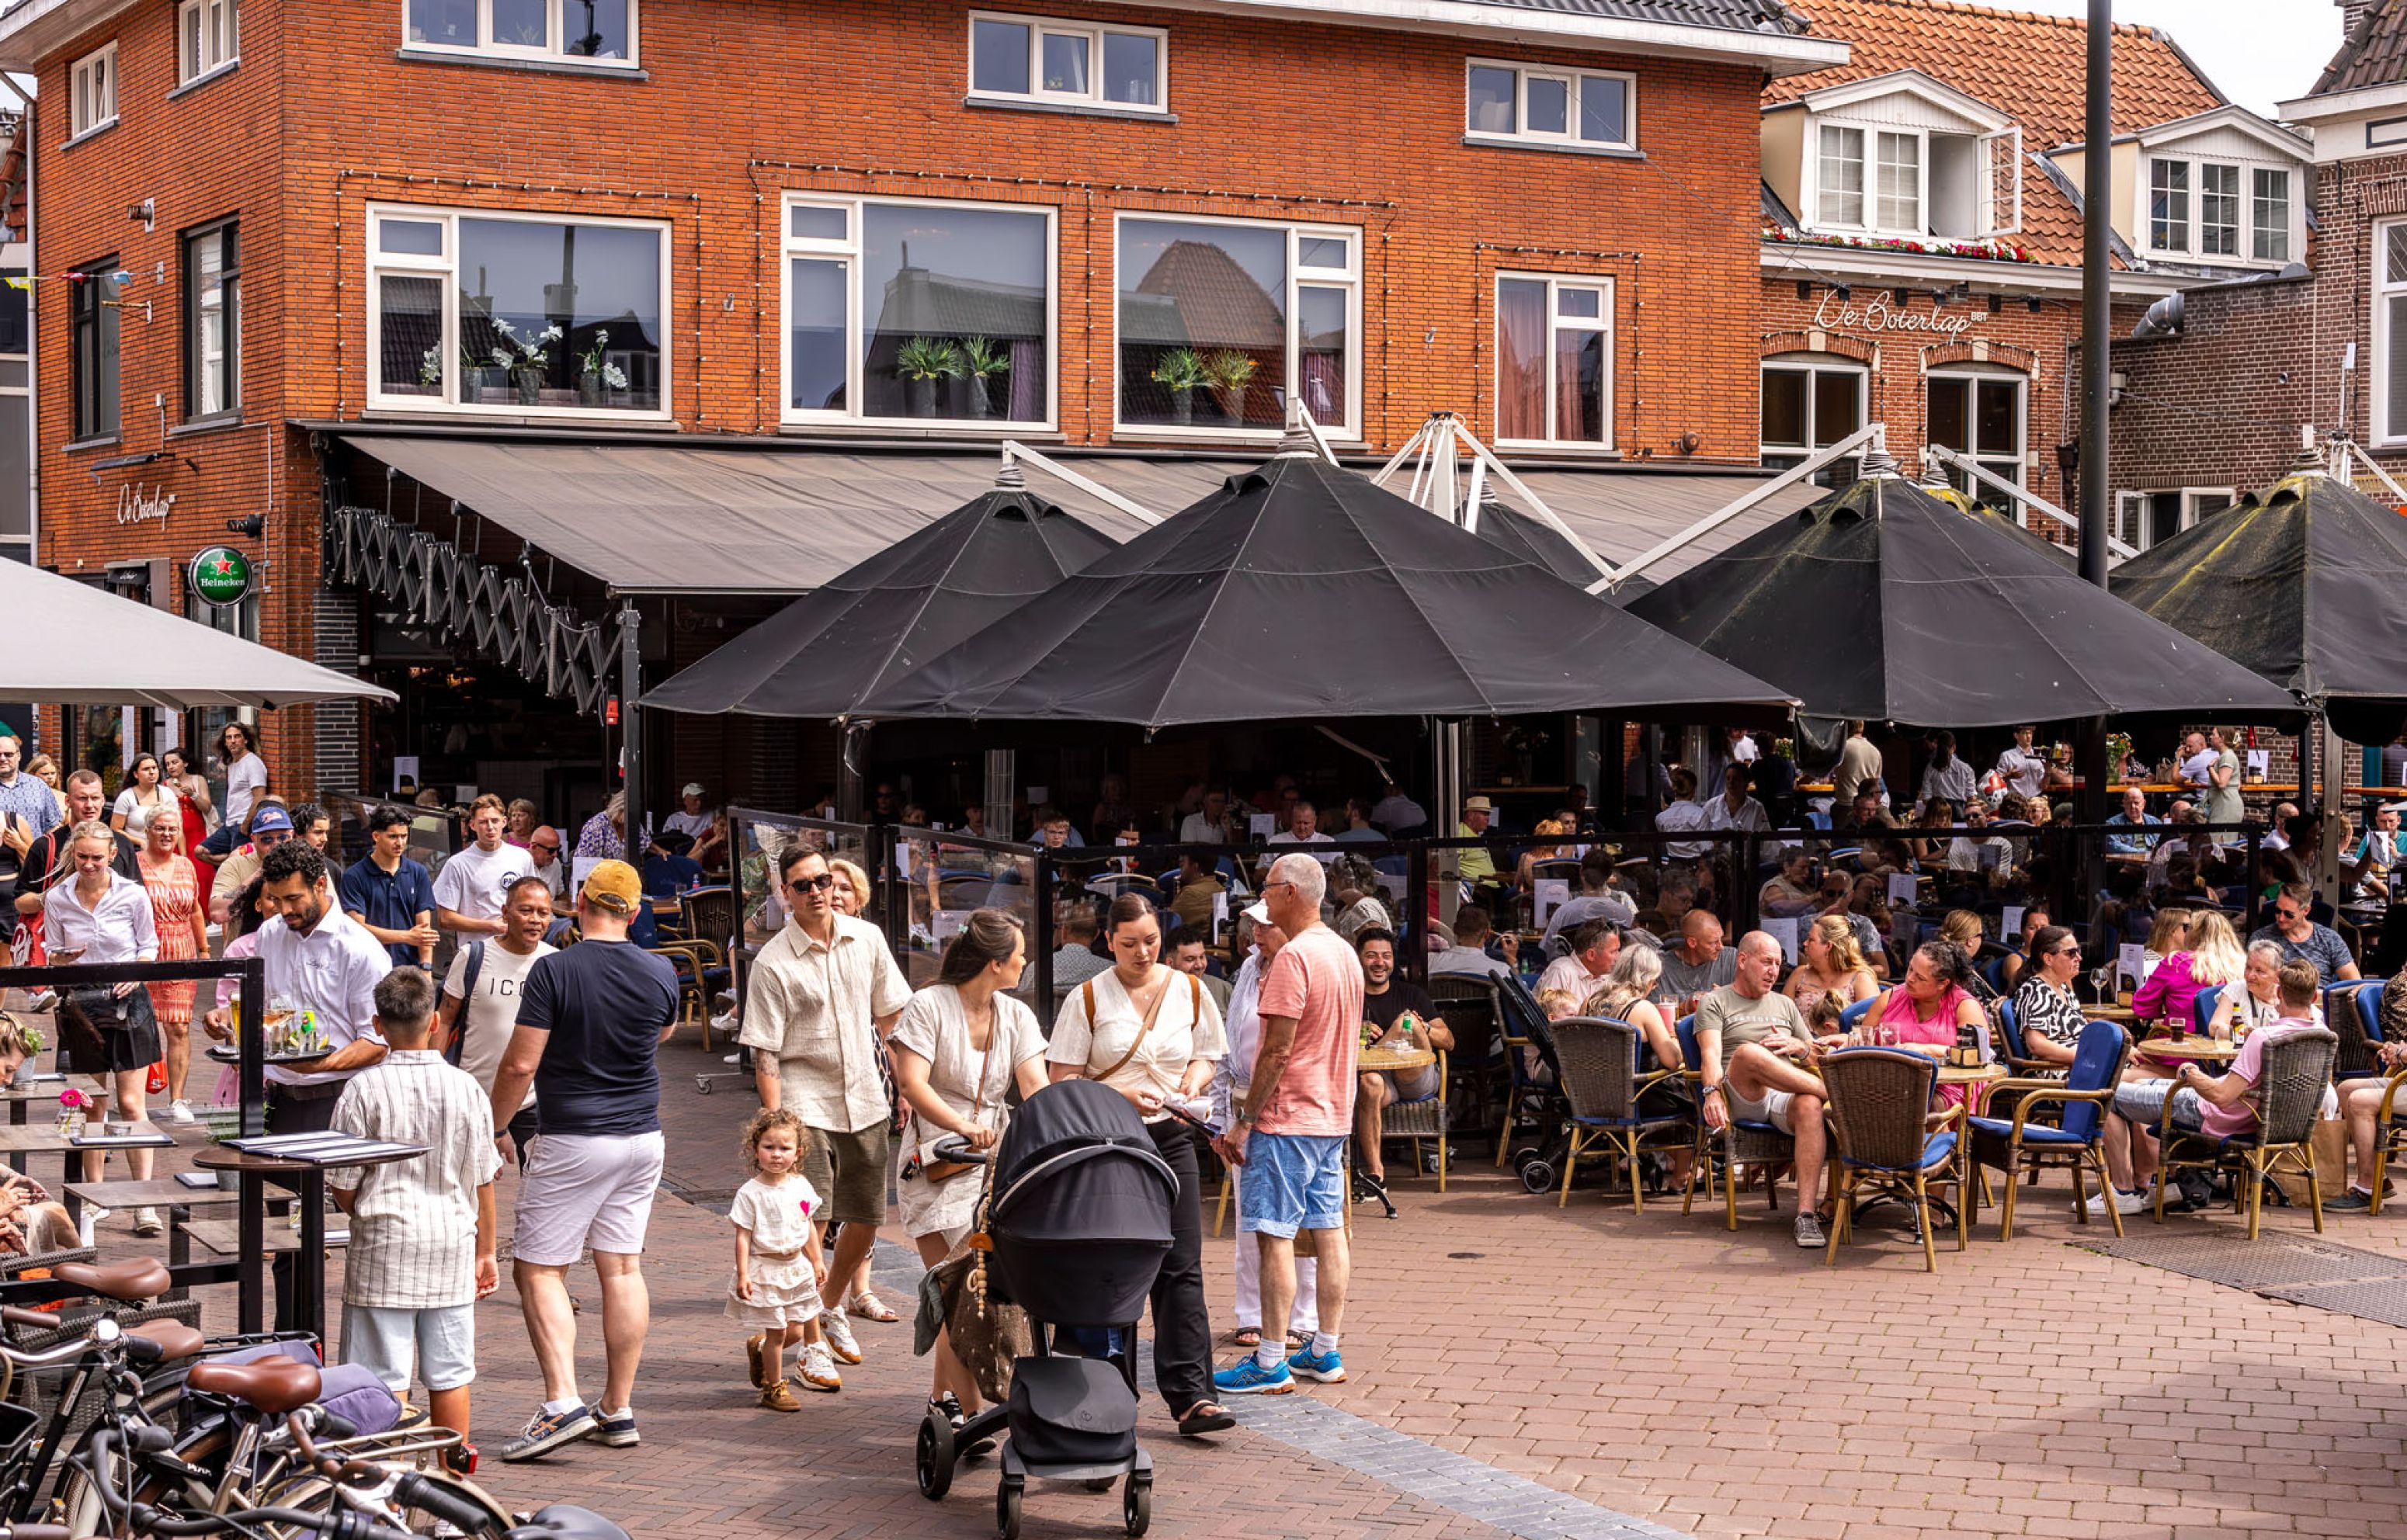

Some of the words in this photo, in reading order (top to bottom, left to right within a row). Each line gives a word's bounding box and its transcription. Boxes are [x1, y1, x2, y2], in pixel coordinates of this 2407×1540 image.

[1814, 289, 1858, 328] De
[1863, 290, 1973, 346] Boterlap
[200, 578, 245, 588] Heineken
